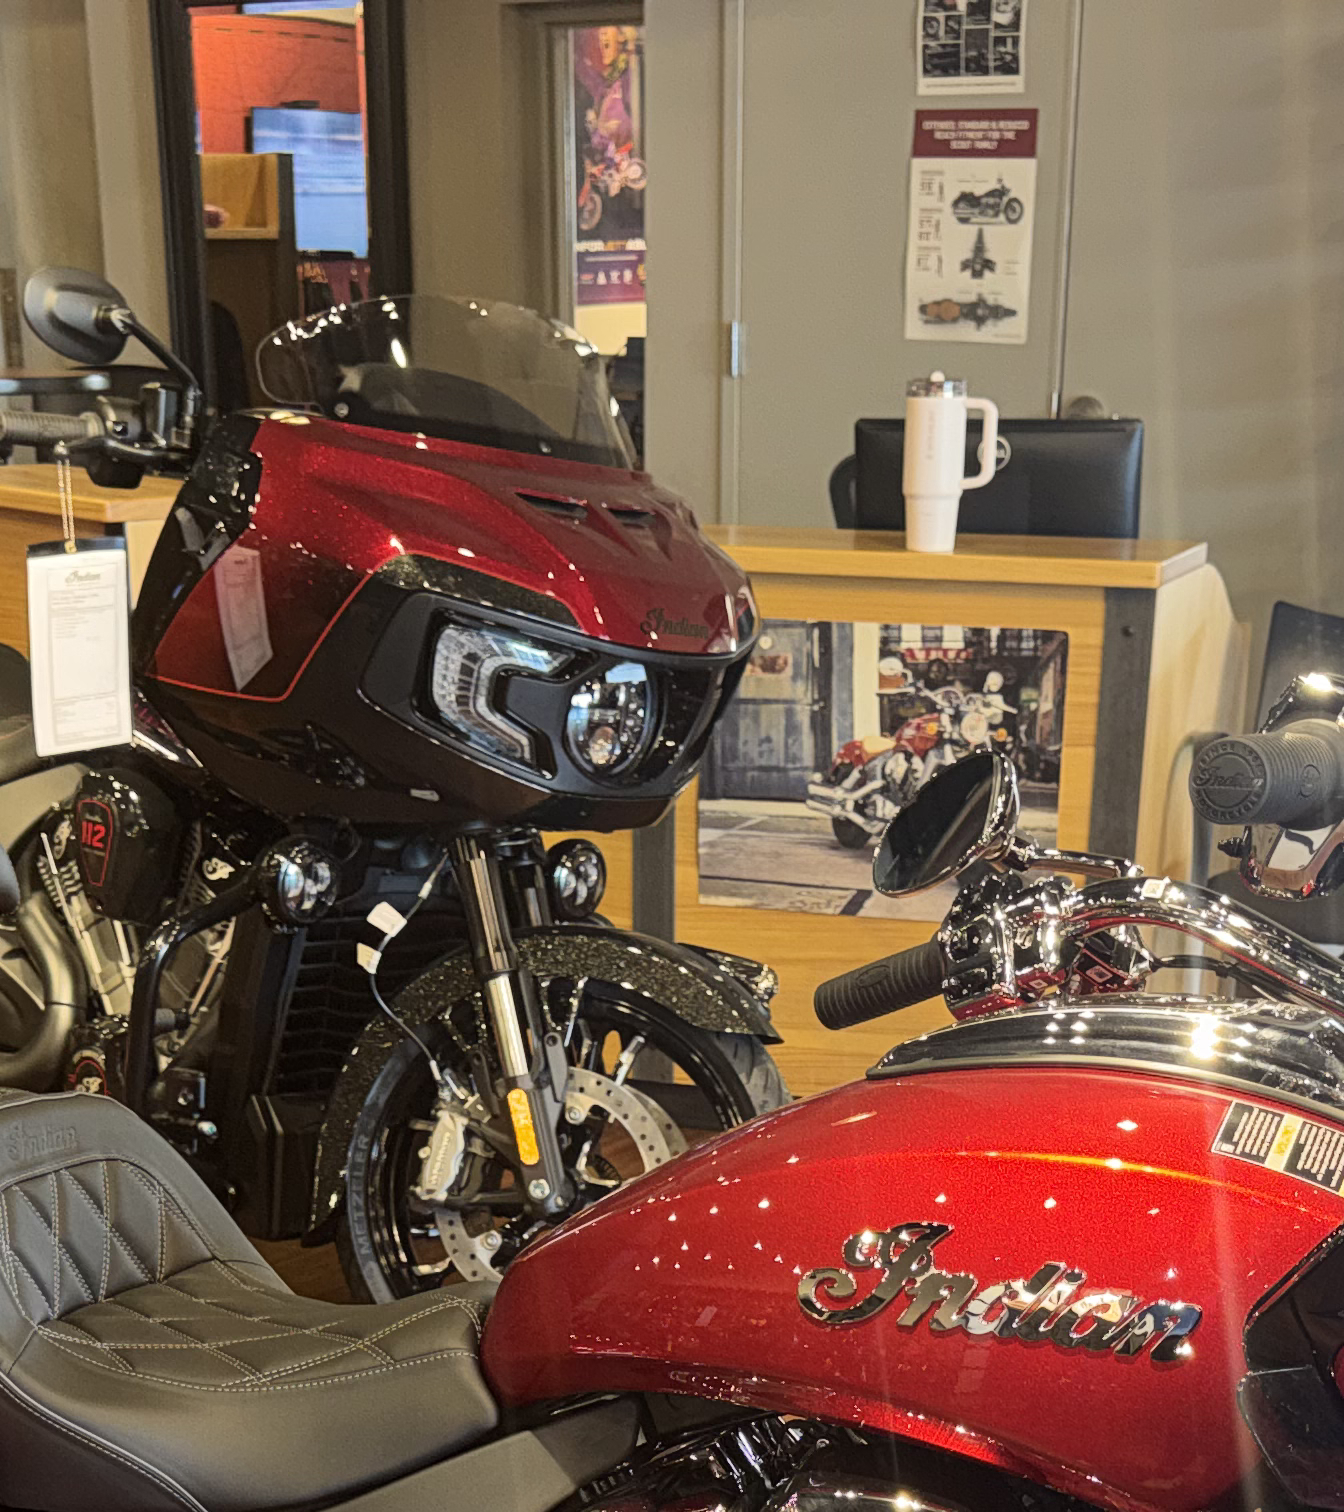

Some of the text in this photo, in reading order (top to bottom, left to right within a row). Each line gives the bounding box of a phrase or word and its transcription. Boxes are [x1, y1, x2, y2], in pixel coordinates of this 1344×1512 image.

[640, 607, 709, 639] Indian
[81, 820, 106, 848] 112
[6, 1120, 77, 1160] Indian
[798, 1222, 1203, 1361] Indian
